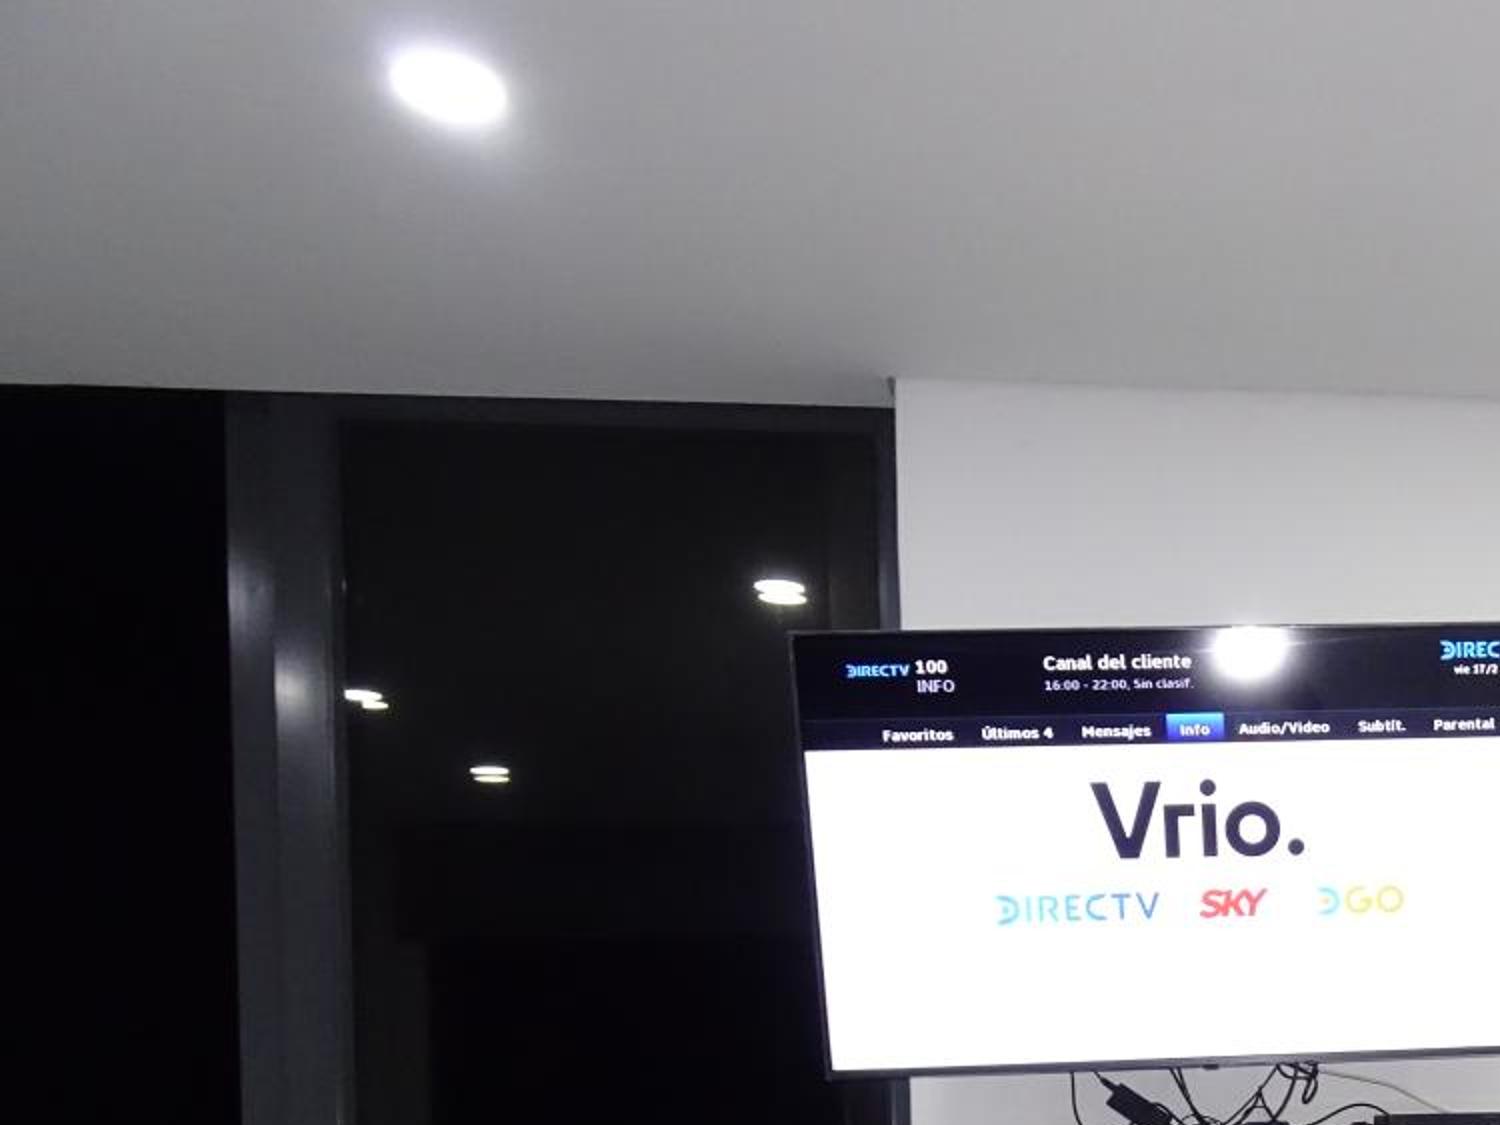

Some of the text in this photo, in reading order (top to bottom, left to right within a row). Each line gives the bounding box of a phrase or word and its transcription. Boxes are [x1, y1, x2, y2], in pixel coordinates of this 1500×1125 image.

[846, 659, 948, 678] DIRECTV 100
[1043, 653, 1192, 671] Canal del cliente
[1453, 666, 1470, 675] vie
[1473, 664, 1498, 676] 17/2
[917, 679, 956, 693] INFO
[1044, 678, 1080, 692] 16:00
[1134, 677, 1152, 690] Sin
[1156, 676, 1195, 690] clasif.
[981, 724, 1054, 741] Últimos 4
[1082, 725, 1152, 740] Mensajes
[1179, 723, 1210, 737] Info
[1433, 717, 1496, 732] Parental
[882, 729, 955, 743] Favoritos
[1090, 779, 1306, 860] Vrio.
[996, 891, 1160, 926] DIRECTV
[1199, 887, 1268, 919] SKY
